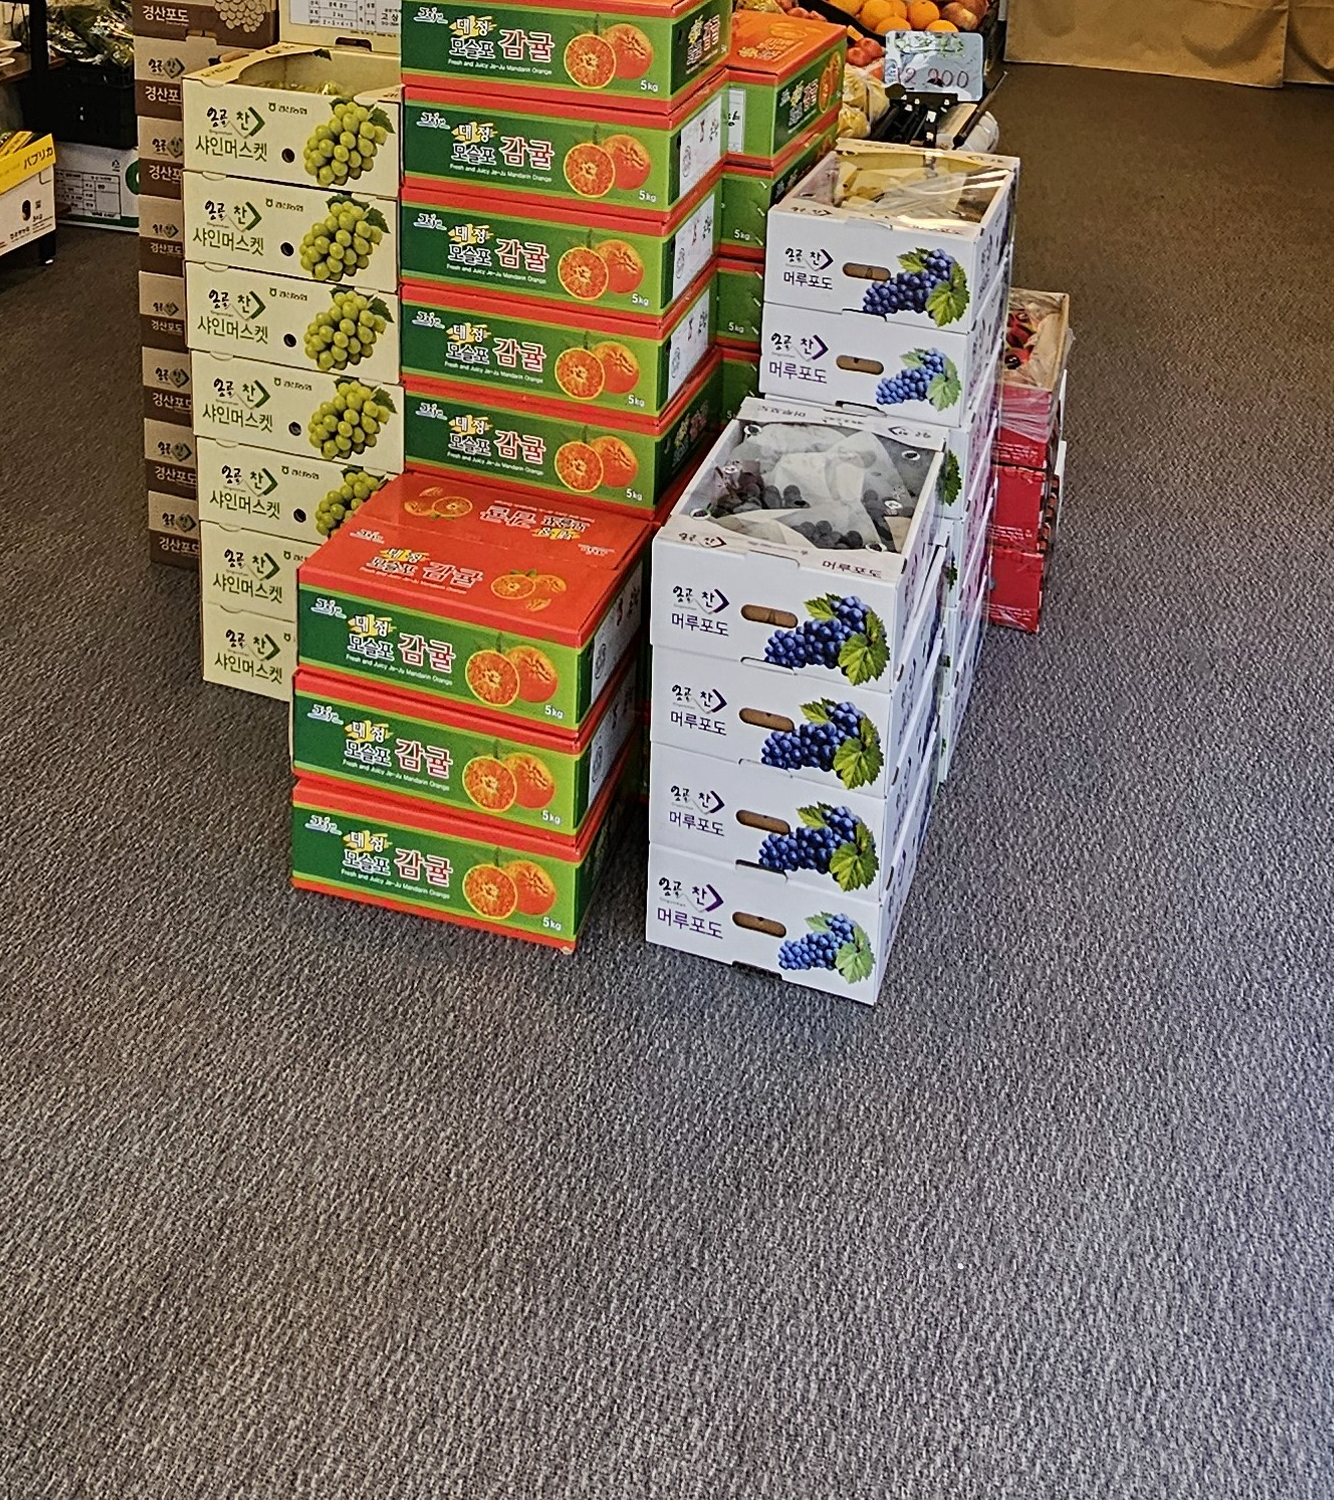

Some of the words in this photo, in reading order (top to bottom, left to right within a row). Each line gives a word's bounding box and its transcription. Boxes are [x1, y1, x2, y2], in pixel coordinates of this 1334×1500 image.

[142, 5, 189, 24] 경산포도
[450, 38, 495, 59] 모슬포
[499, 29, 555, 63] 감귤
[640, 80, 659, 93] 5kg
[196, 134, 267, 163] 샤인머스켓
[451, 144, 496, 164] 모슬포
[499, 136, 555, 170] 감귤
[638, 190, 657, 203] 5kg
[784, 270, 833, 290] 머루포도
[197, 317, 268, 345] 샤인머스켓
[769, 361, 827, 384] 머루포도
[449, 434, 491, 457] 모슬포
[494, 430, 547, 465] 감귤
[210, 491, 280, 520] 샤인머스켓
[626, 488, 643, 502] 5kg
[422, 562, 482, 590] 감귤
[823, 559, 882, 579] 머루포도
[212, 575, 283, 604] 샤인머스켓
[671, 613, 730, 638] 머루포도
[214, 652, 283, 681] 샤인머스켓
[348, 634, 395, 662] 모슬포
[398, 633, 456, 674] 감귤
[544, 704, 564, 720] 5kg
[670, 711, 727, 736] 머루포도
[345, 740, 392, 767] 모슬포
[395, 739, 453, 779] 감귤
[342, 759, 358, 769] Fresh
[359, 763, 369, 772] and
[429, 779, 450, 792] Orange
[542, 811, 562, 825] 5kg
[669, 811, 725, 837] 머루포도
[343, 850, 391, 876] 모슬포
[394, 848, 453, 887] 감귤
[542, 917, 562, 931] 5kg
[657, 906, 724, 940] 머루포도
